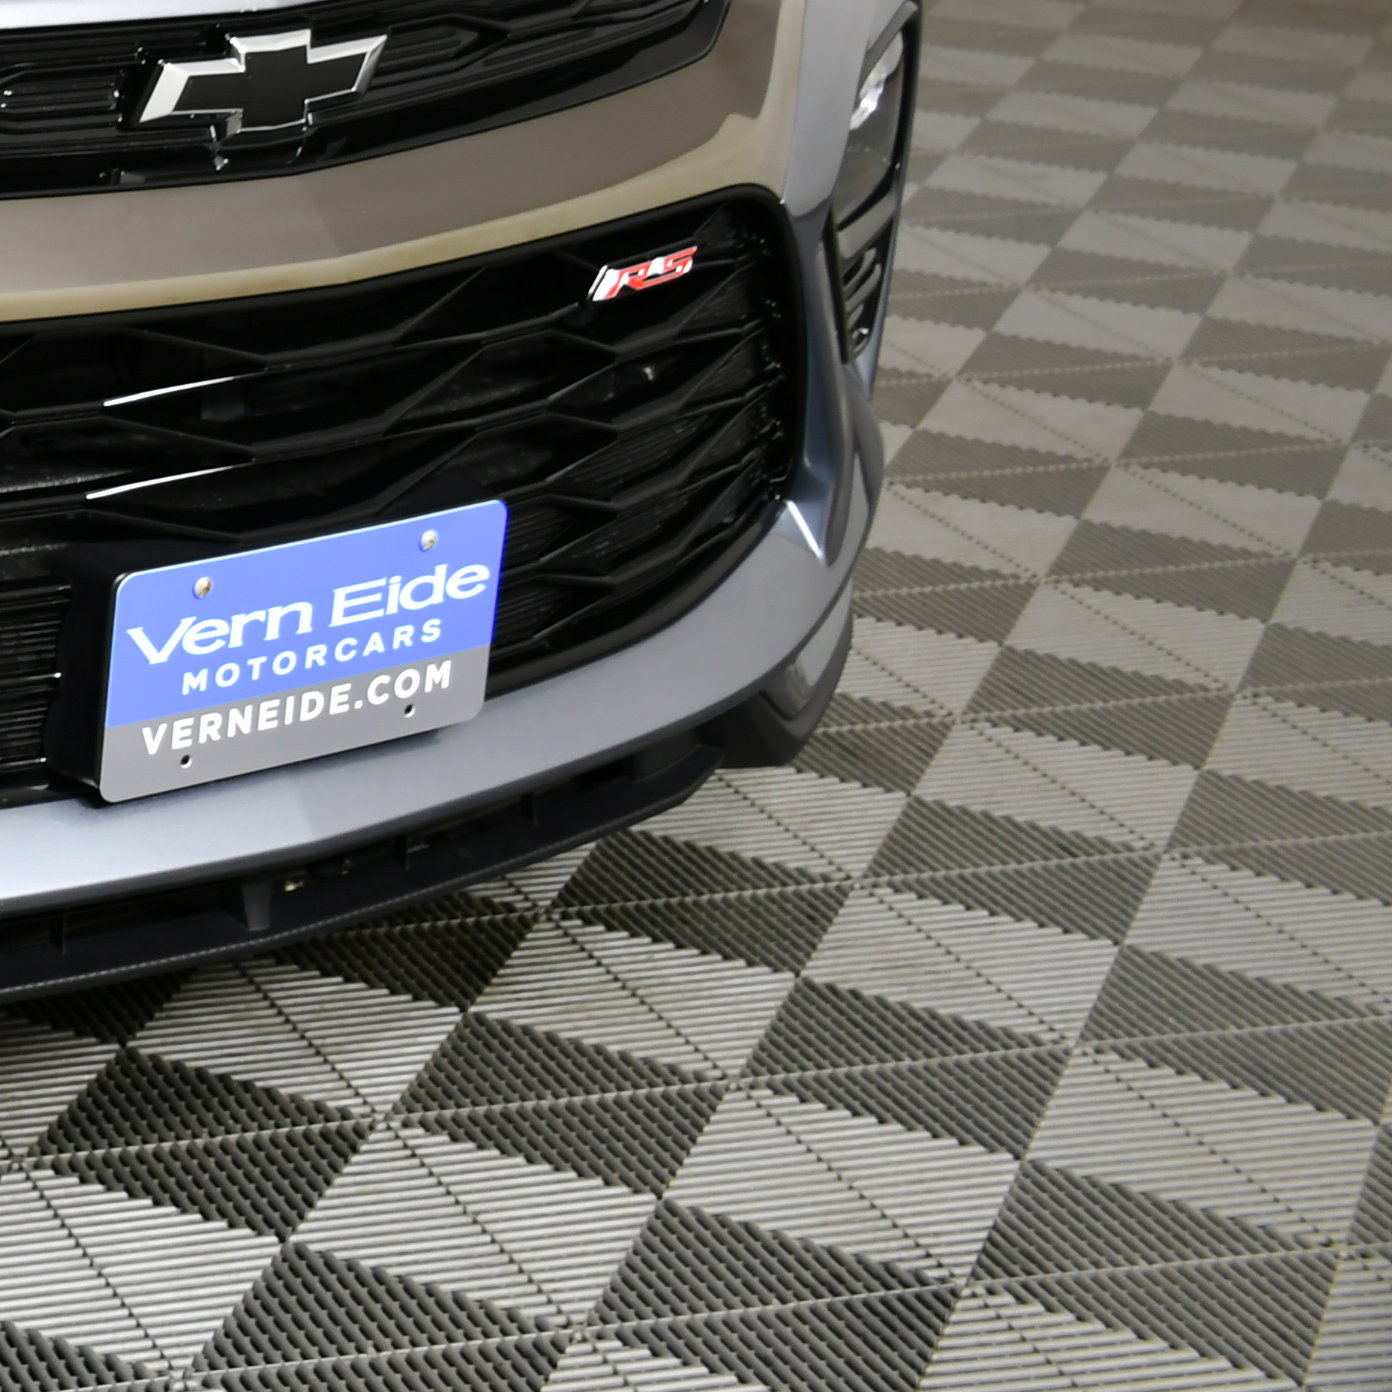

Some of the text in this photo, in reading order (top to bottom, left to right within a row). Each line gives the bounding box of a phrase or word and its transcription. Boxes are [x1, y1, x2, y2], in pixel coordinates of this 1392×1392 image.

[590, 245, 698, 301] RS
[127, 564, 490, 665] Vern Eide
[182, 618, 442, 695] MOTORCARS
[142, 660, 452, 755] VERNEIDE.COM
